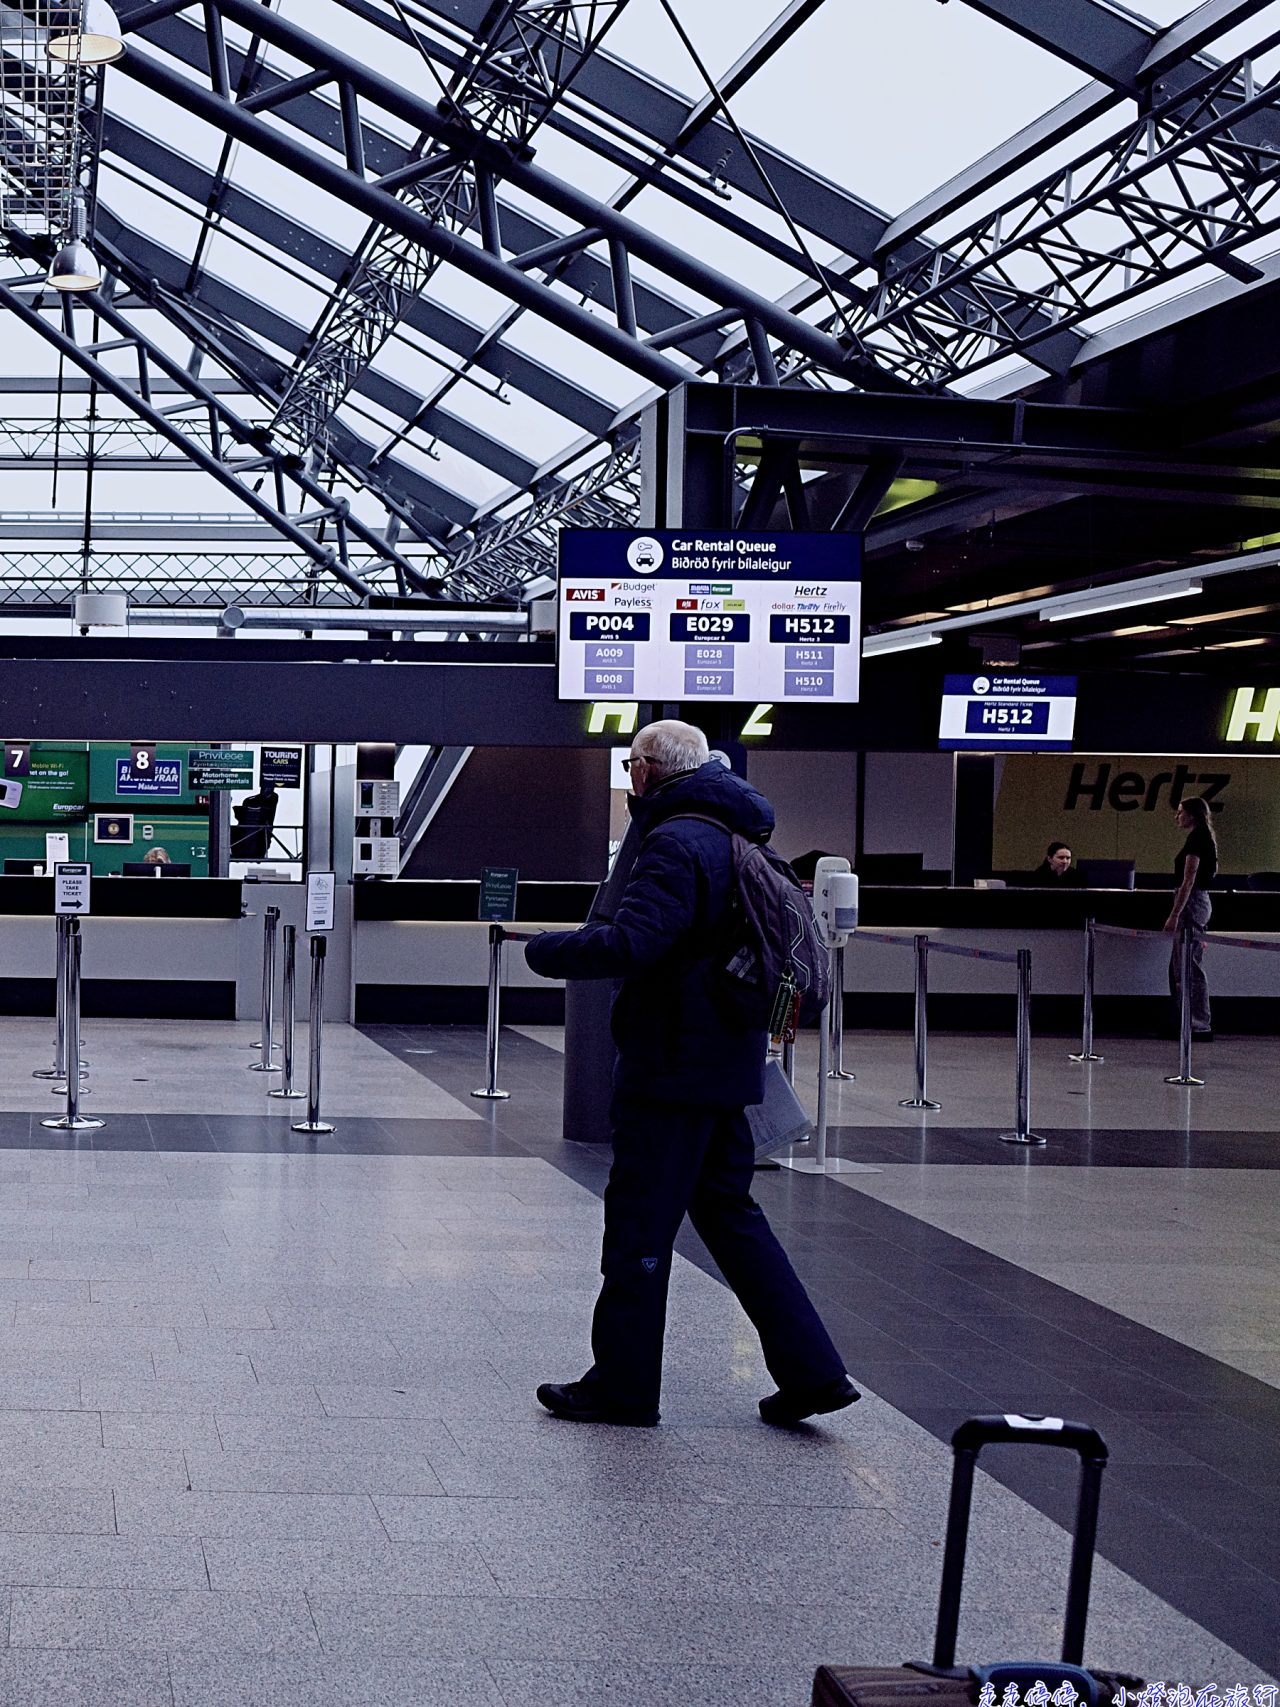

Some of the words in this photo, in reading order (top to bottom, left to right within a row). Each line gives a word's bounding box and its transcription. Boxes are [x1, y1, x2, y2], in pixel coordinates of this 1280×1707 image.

[671, 539, 693, 551] Car
[695, 539, 734, 552] Rental
[736, 540, 776, 554] Queue
[671, 557, 709, 569] Biðröð
[712, 557, 736, 572] fyrir
[738, 557, 792, 573] bílaleigur
[623, 582, 656, 593] Budget
[794, 586, 828, 596] Hertz
[571, 590, 600, 600] AVIS
[614, 597, 652, 609] Payless
[700, 599, 721, 611] fox
[586, 615, 634, 631] P004
[686, 616, 734, 632] E029
[785, 618, 835, 634] H512
[595, 648, 623, 657] A009
[696, 649, 723, 659] E028
[795, 650, 823, 660] H511
[595, 674, 623, 684] B008
[696, 675, 722, 685] E027
[795, 676, 823, 686] H510
[1022, 678, 1040, 686] Queue
[982, 709, 1033, 724] H512
[11, 750, 24, 768] 7
[136, 751, 149, 769] 8
[1063, 763, 1232, 812] Hertz
[53, 803, 85, 811] Europcar
